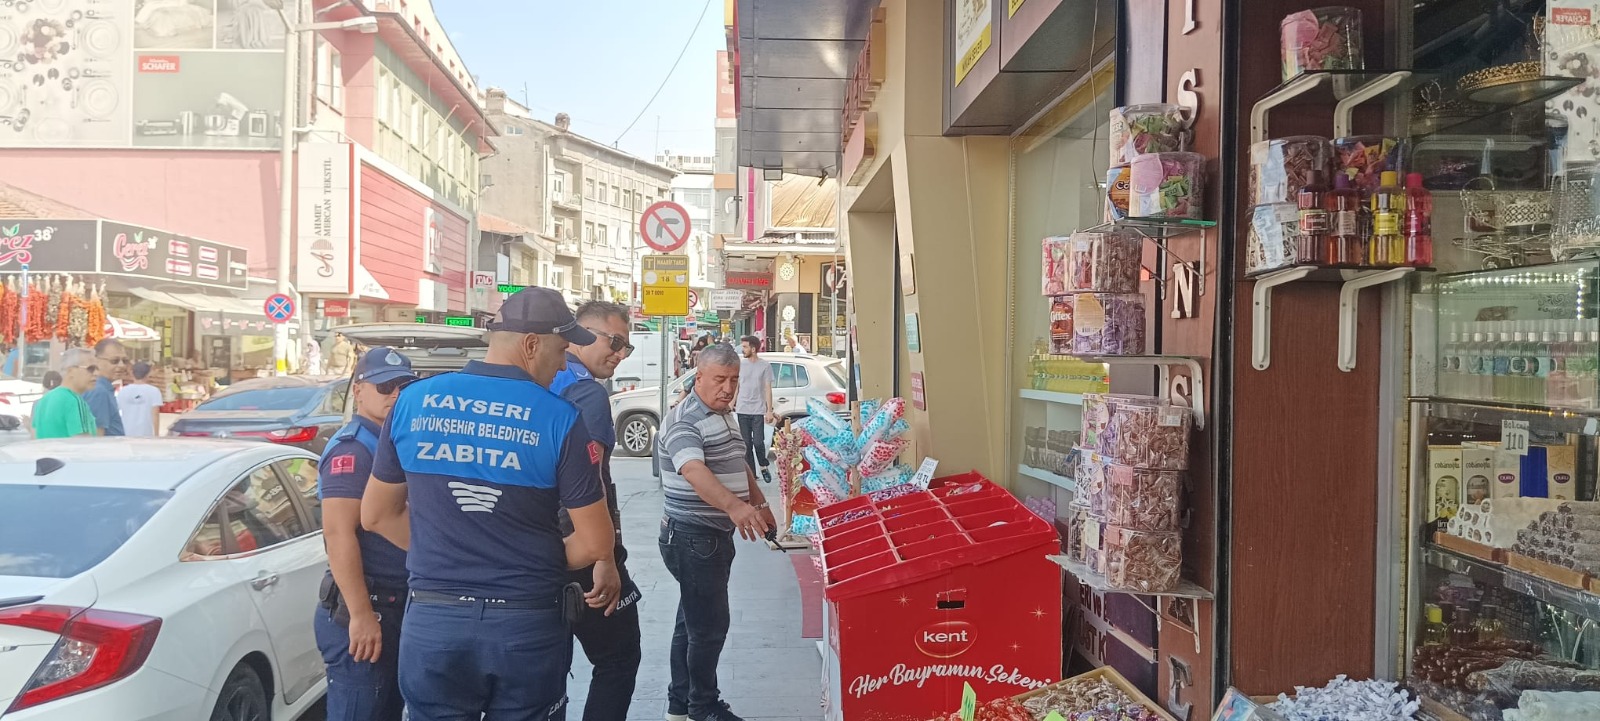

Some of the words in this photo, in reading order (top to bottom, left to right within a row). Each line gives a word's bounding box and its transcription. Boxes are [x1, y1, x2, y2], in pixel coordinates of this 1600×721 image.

[314, 204, 322, 236] AHMET
[323, 199, 332, 237] MERCAN
[416, 441, 522, 471] ZABITA
[1506, 432, 1525, 451] 110
[616, 589, 639, 610] ZABITA
[923, 630, 968, 643] kent
[849, 674, 889, 699] Her
[889, 663, 985, 688] Bayramın
